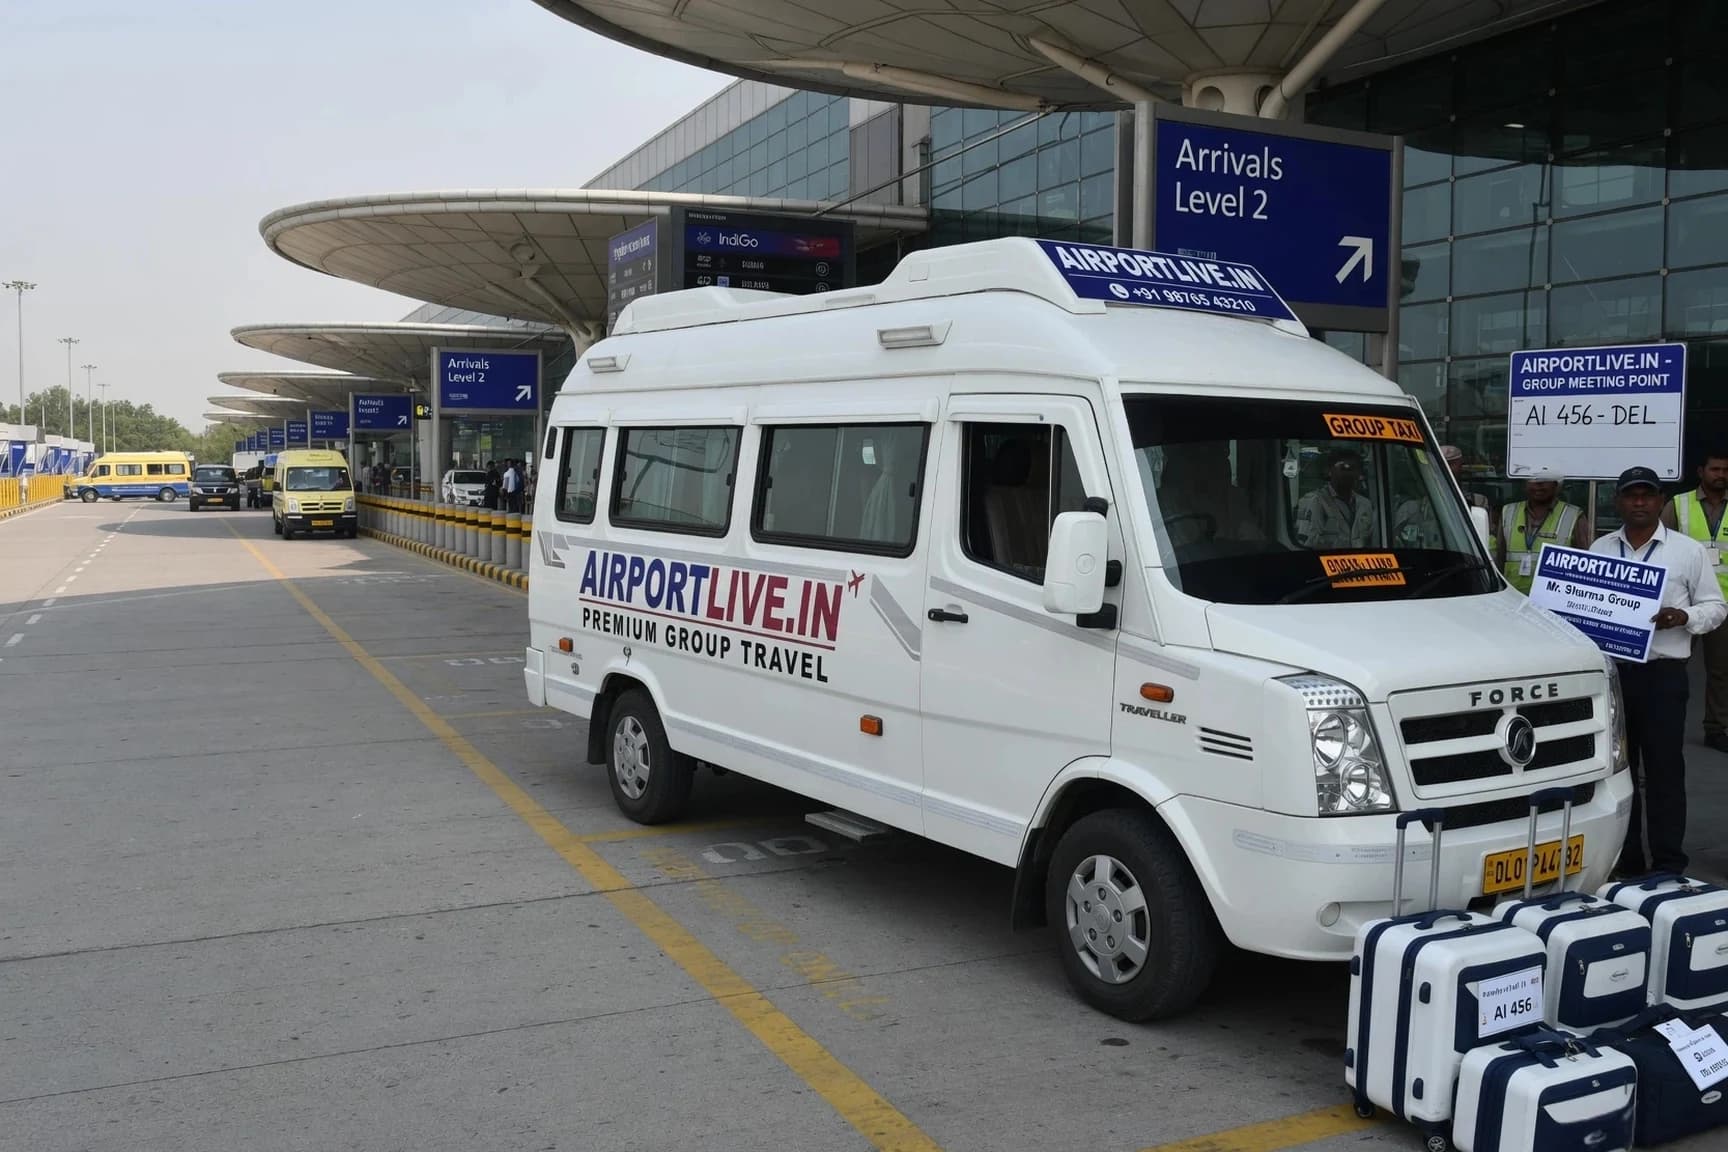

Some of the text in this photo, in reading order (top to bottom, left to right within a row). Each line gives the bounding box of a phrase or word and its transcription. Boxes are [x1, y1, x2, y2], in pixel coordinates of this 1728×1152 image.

[1175, 137, 1284, 181] Arrivals
[1175, 181, 1268, 220] Level 2
[1055, 245, 1265, 292] AIRPORTLIVE.IN
[1132, 286, 1257, 313] +91 98765 43210
[447, 357, 490, 371] Arrivals
[1520, 352, 1660, 374] AIRPORTLIVE.IN
[448, 371, 485, 383] Level 2
[1522, 373, 1670, 391] GROUP MEETING POINT
[1525, 404, 1546, 426] AI
[1557, 404, 1593, 426] 456
[1611, 404, 1656, 425] DEL
[1330, 417, 1421, 440] GROUP TAXI
[1545, 550, 1660, 588] AIRPORTLIVE.IN
[579, 549, 843, 642] AIRPORTLIVE.IN
[1546, 581, 1561, 594] Mr.
[1608, 592, 1642, 611] Group
[582, 607, 829, 683] PREMIUM GROUP TRAVEL
[1468, 682, 1559, 708] FORCE
[1119, 702, 1187, 725] TRAVELLER
[1494, 997, 1532, 1021] AI 456
